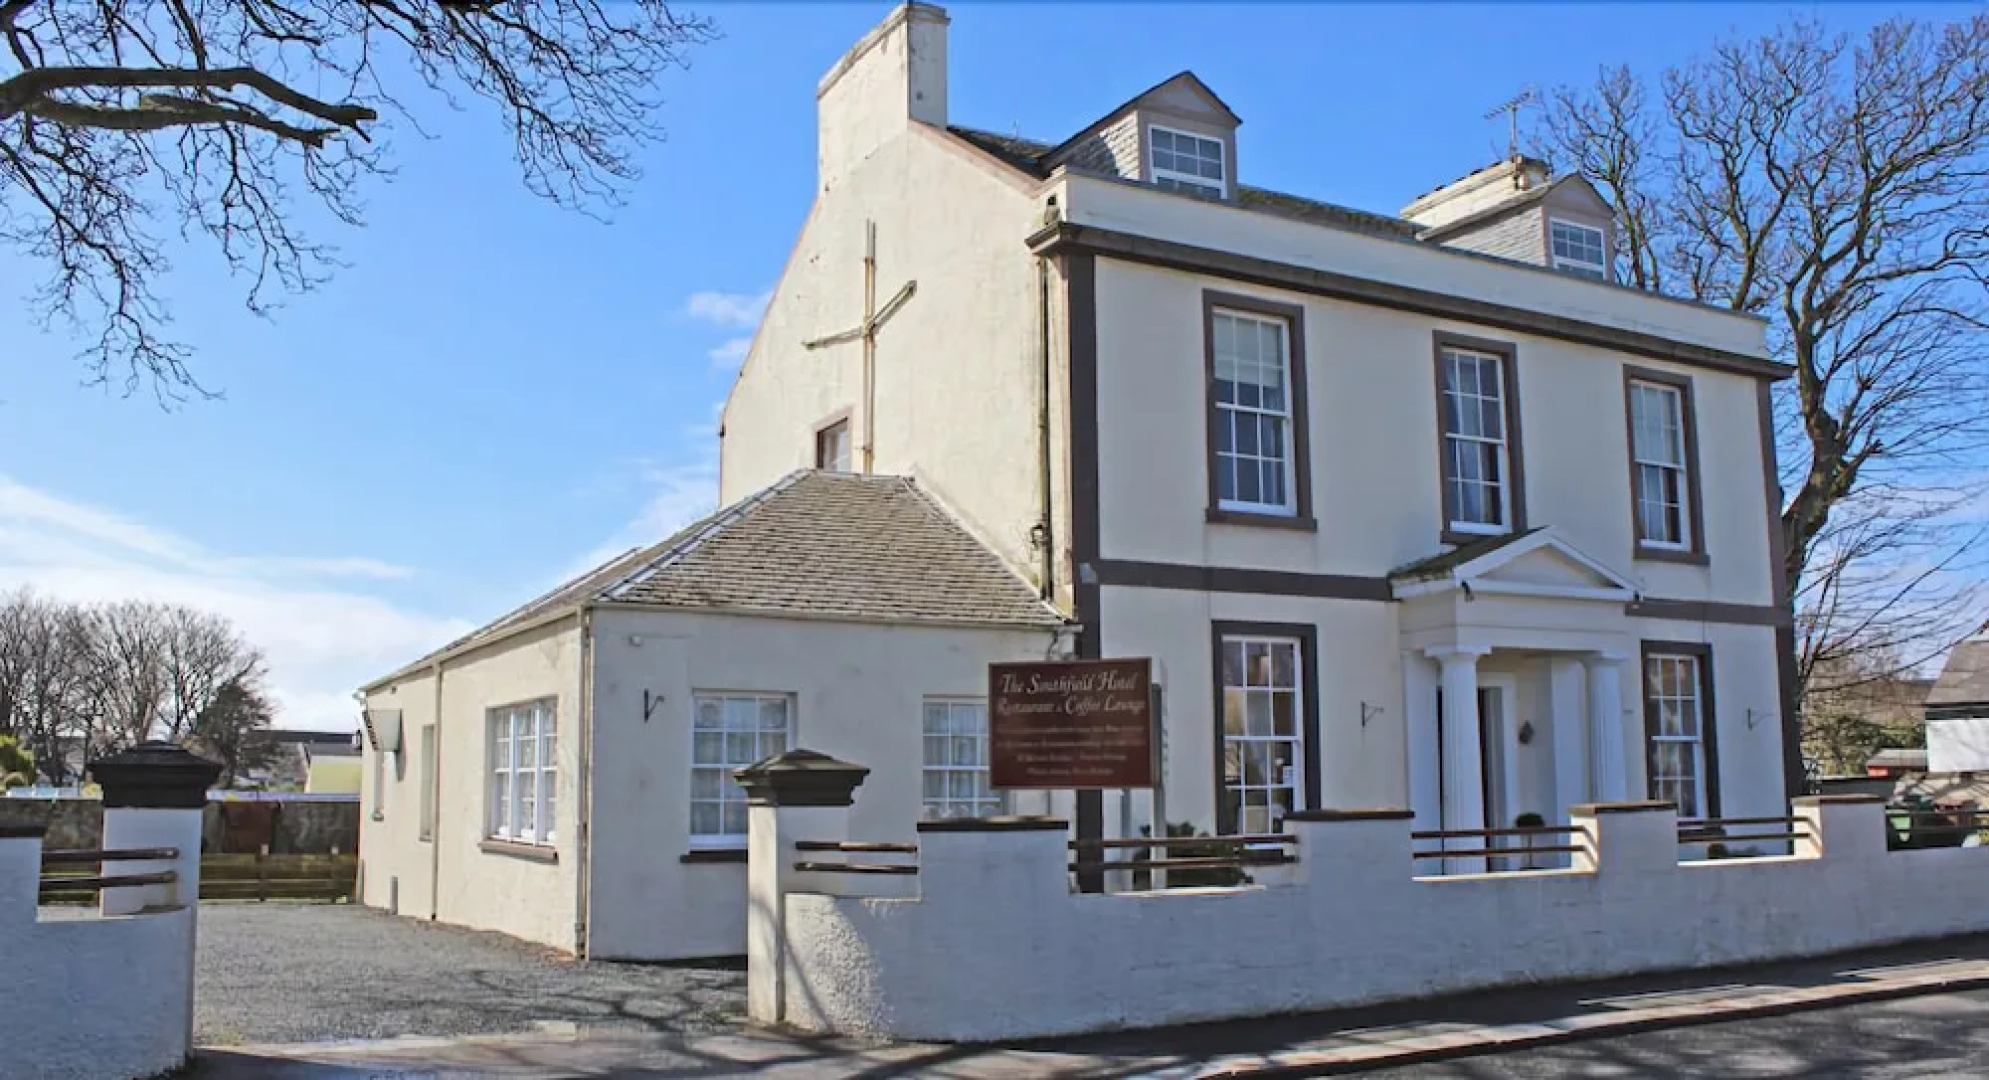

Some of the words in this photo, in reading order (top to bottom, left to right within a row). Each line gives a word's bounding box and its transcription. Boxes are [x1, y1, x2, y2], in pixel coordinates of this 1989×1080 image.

[1002, 673, 1024, 693] The
[1027, 673, 1093, 696] Southfield
[1098, 669, 1139, 691] Hotel
[999, 697, 1055, 716] Restaurant
[1065, 695, 1101, 717] Coffee
[1104, 694, 1146, 714] Lounge
